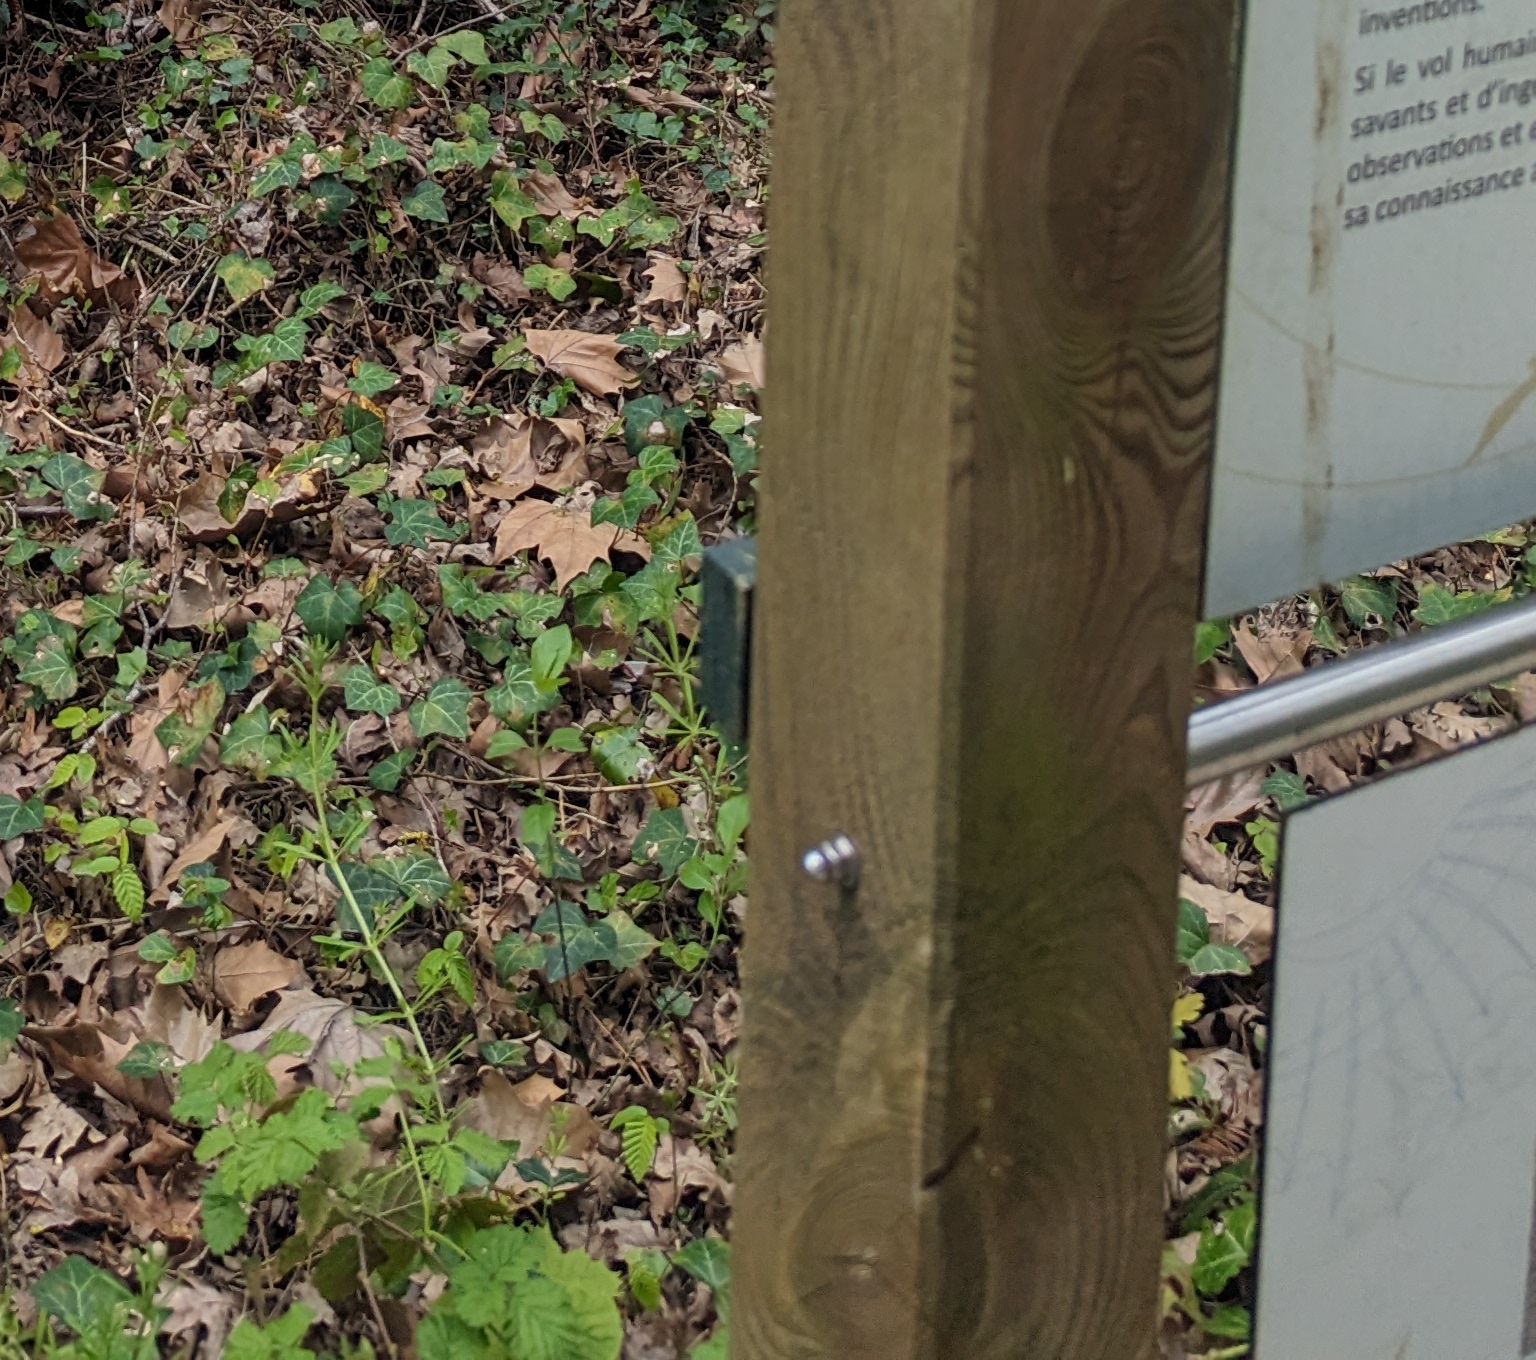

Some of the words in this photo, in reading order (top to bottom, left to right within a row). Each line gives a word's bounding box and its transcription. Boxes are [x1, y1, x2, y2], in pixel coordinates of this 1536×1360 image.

[1353, 63, 1377, 95] Si
[1384, 58, 1407, 87] le
[1417, 45, 1454, 79] vol
[1349, 99, 1438, 141] savants
[1445, 91, 1469, 117] et
[1346, 132, 1495, 184] observations
[1500, 120, 1524, 148] et
[1343, 205, 1369, 230] sa
[1374, 166, 1525, 221] connaissance
